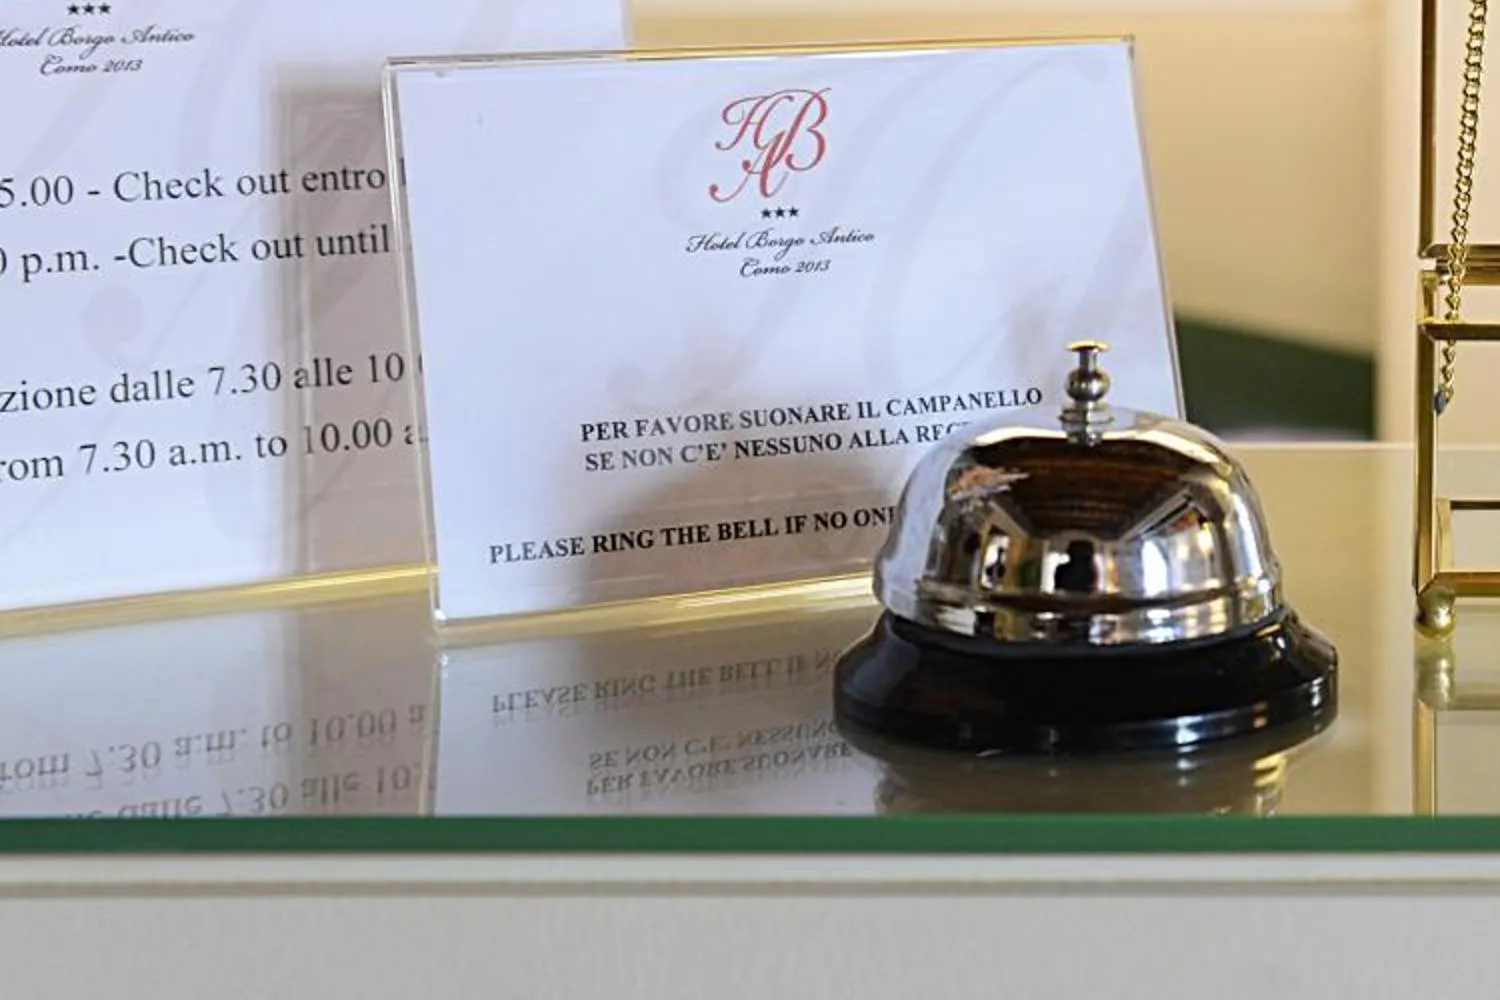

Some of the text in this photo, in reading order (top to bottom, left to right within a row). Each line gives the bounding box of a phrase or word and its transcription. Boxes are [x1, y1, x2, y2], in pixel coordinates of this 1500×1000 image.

[49, 24, 115, 60] Borgo
[121, 23, 195, 45] Antico
[40, 54, 143, 76] Como 2013
[114, 168, 223, 203] Check
[236, 164, 289, 196] out
[302, 162, 386, 193] entro
[21, 246, 99, 283] p.m.
[251, 230, 303, 261] out
[316, 223, 390, 257] until
[685, 226, 875, 261] Hotel Borgo Antico
[739, 257, 831, 278] Como 2013
[0, 380, 96, 412] zione
[110, 370, 196, 404] dalle
[208, 361, 281, 396] 7.30
[294, 355, 354, 389] alle
[580, 387, 1043, 443] PER FAVORE SUONARE IL CAMPANELLO
[78, 437, 156, 475] 7.30
[168, 437, 242, 467] a.m.
[257, 432, 288, 460] to
[304, 416, 393, 454] 10.00
[585, 451, 613, 472] SE
[622, 446, 675, 469] NON
[734, 432, 843, 460] NESSUNO
[848, 426, 909, 450] ALLA
[489, 536, 585, 564] PLEASE
[592, 529, 654, 553] RING
[661, 523, 711, 547] THE
[717, 516, 776, 541] BELL
[784, 513, 808, 535] IF
[813, 510, 848, 531] NO
